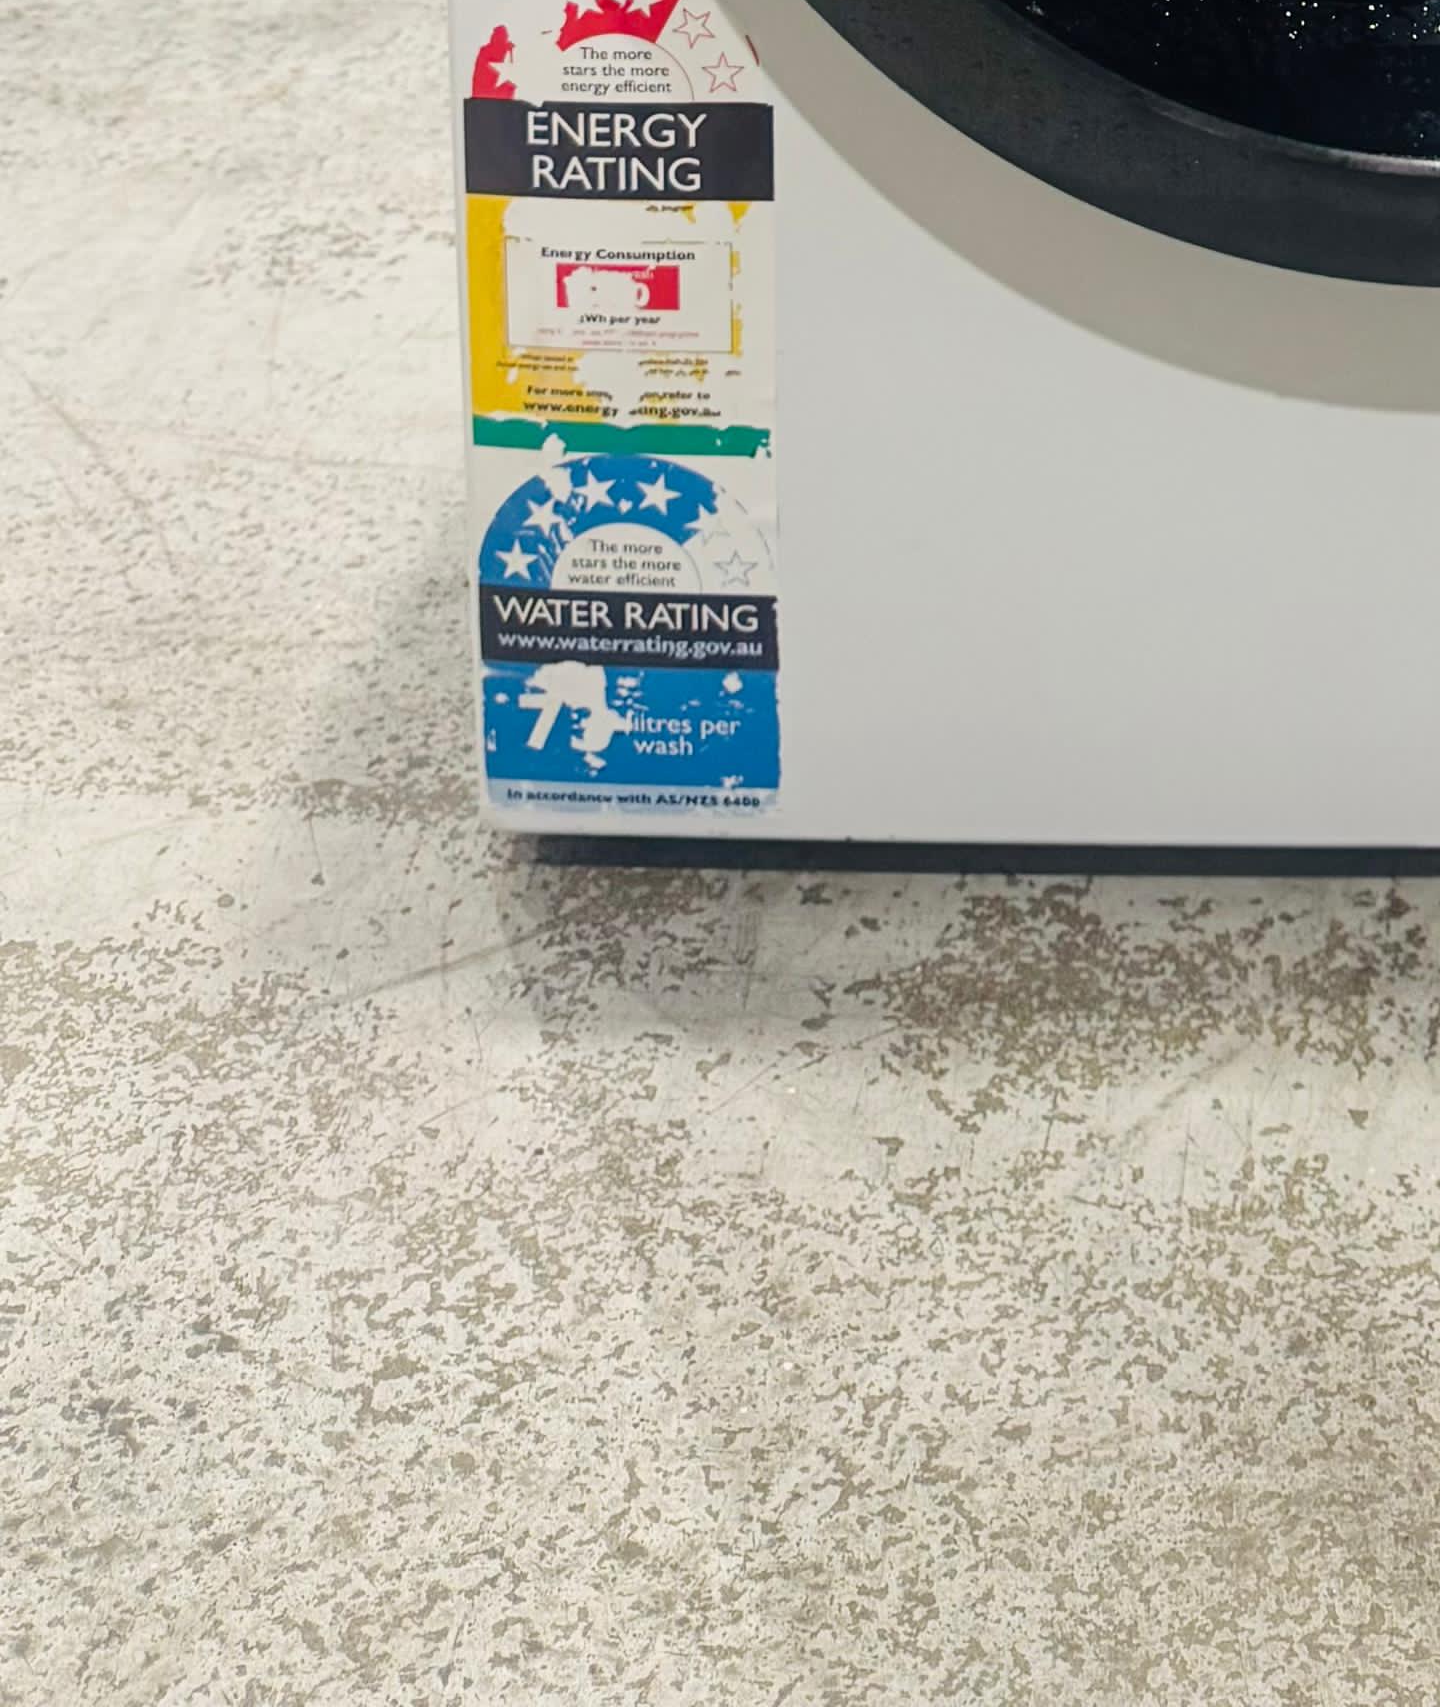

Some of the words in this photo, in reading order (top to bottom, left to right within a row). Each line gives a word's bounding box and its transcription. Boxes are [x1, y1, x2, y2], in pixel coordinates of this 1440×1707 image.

[580, 47, 607, 61] The
[613, 49, 652, 61] more
[563, 66, 598, 77] stars
[602, 64, 627, 77] the
[631, 67, 670, 77] more
[561, 82, 610, 96] energy
[615, 80, 672, 94] efficient
[527, 110, 707, 148] ENERGY
[532, 154, 702, 193] RATING
[541, 246, 592, 262] Energy
[596, 248, 696, 263] Consumption
[609, 315, 632, 326] per
[635, 315, 661, 326] year
[527, 385, 548, 396] For
[590, 538, 618, 554] The
[623, 542, 663, 554] more
[571, 557, 607, 570] stars
[612, 558, 636, 571] the
[641, 559, 682, 572] more
[567, 574, 610, 586] water
[616, 573, 676, 588] efficient
[494, 595, 613, 629] WATER
[624, 601, 760, 633] RATING
[498, 633, 763, 660] www.waterrating.gov.au
[633, 712, 693, 735] litres
[700, 718, 741, 740] per
[634, 736, 694, 756] wash
[617, 793, 652, 805] with
